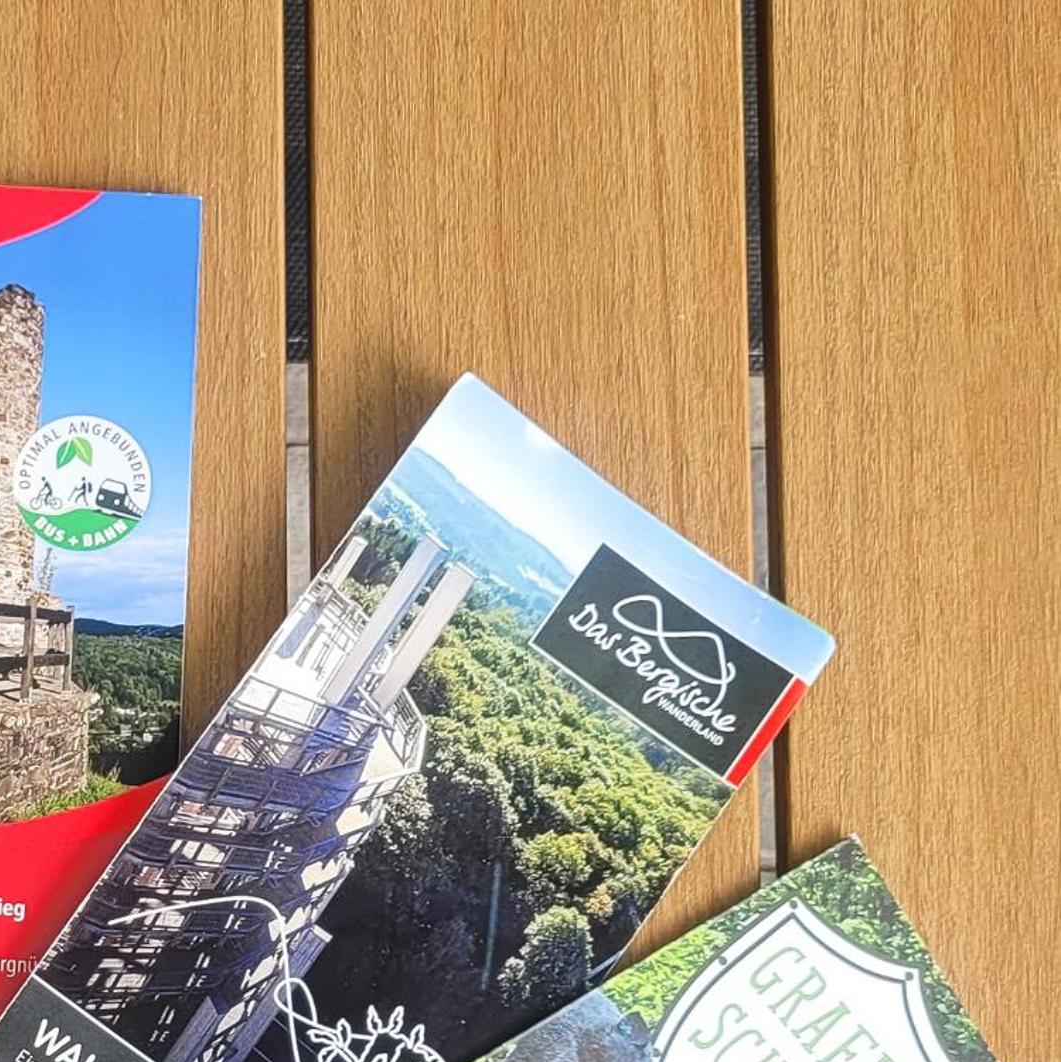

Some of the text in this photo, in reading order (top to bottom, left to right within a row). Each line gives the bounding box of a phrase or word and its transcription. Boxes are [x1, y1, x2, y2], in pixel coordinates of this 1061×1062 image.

[18, 421, 146, 493] OPTIMAL ANGEBUNDEN
[34, 516, 66, 542] BUS
[82, 518, 128, 547] BAHN
[568, 603, 736, 735] Das Bergische
[657, 696, 724, 746] WANDERLAND
